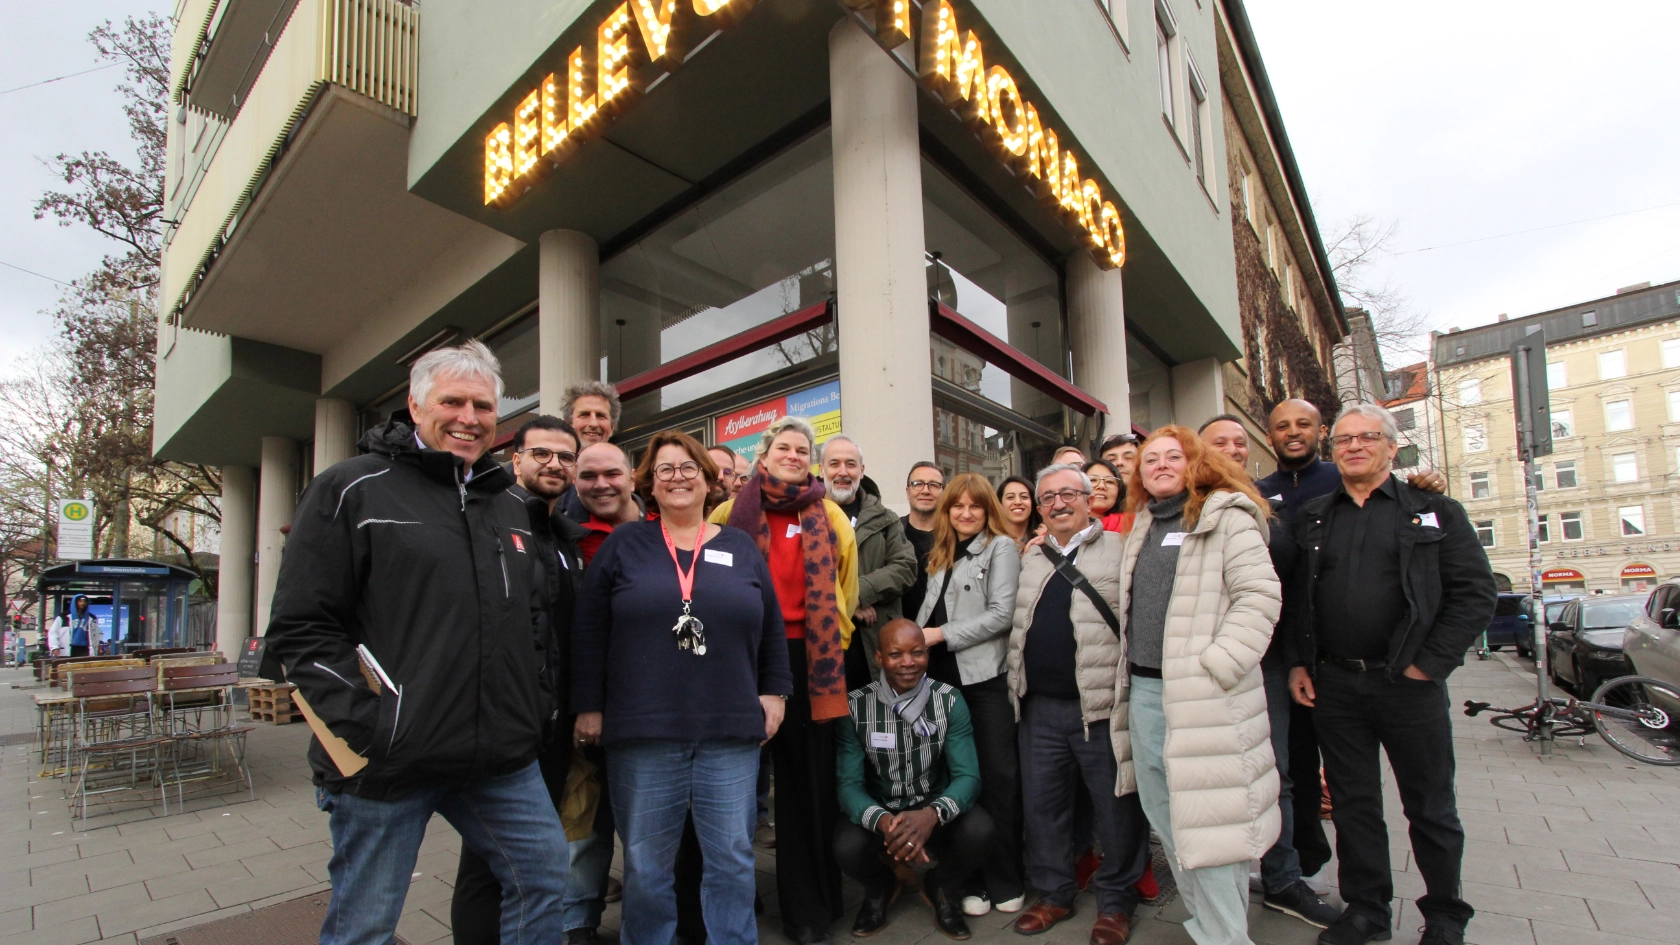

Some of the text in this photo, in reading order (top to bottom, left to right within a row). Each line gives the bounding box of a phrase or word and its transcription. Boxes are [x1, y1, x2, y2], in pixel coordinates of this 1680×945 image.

[484, 0, 730, 206] BELLEV
[932, 0, 1125, 268] MONACO
[790, 397, 829, 413] Migrations
[725, 410, 777, 435] Asylberatung
[1624, 542, 1680, 554] SIND
